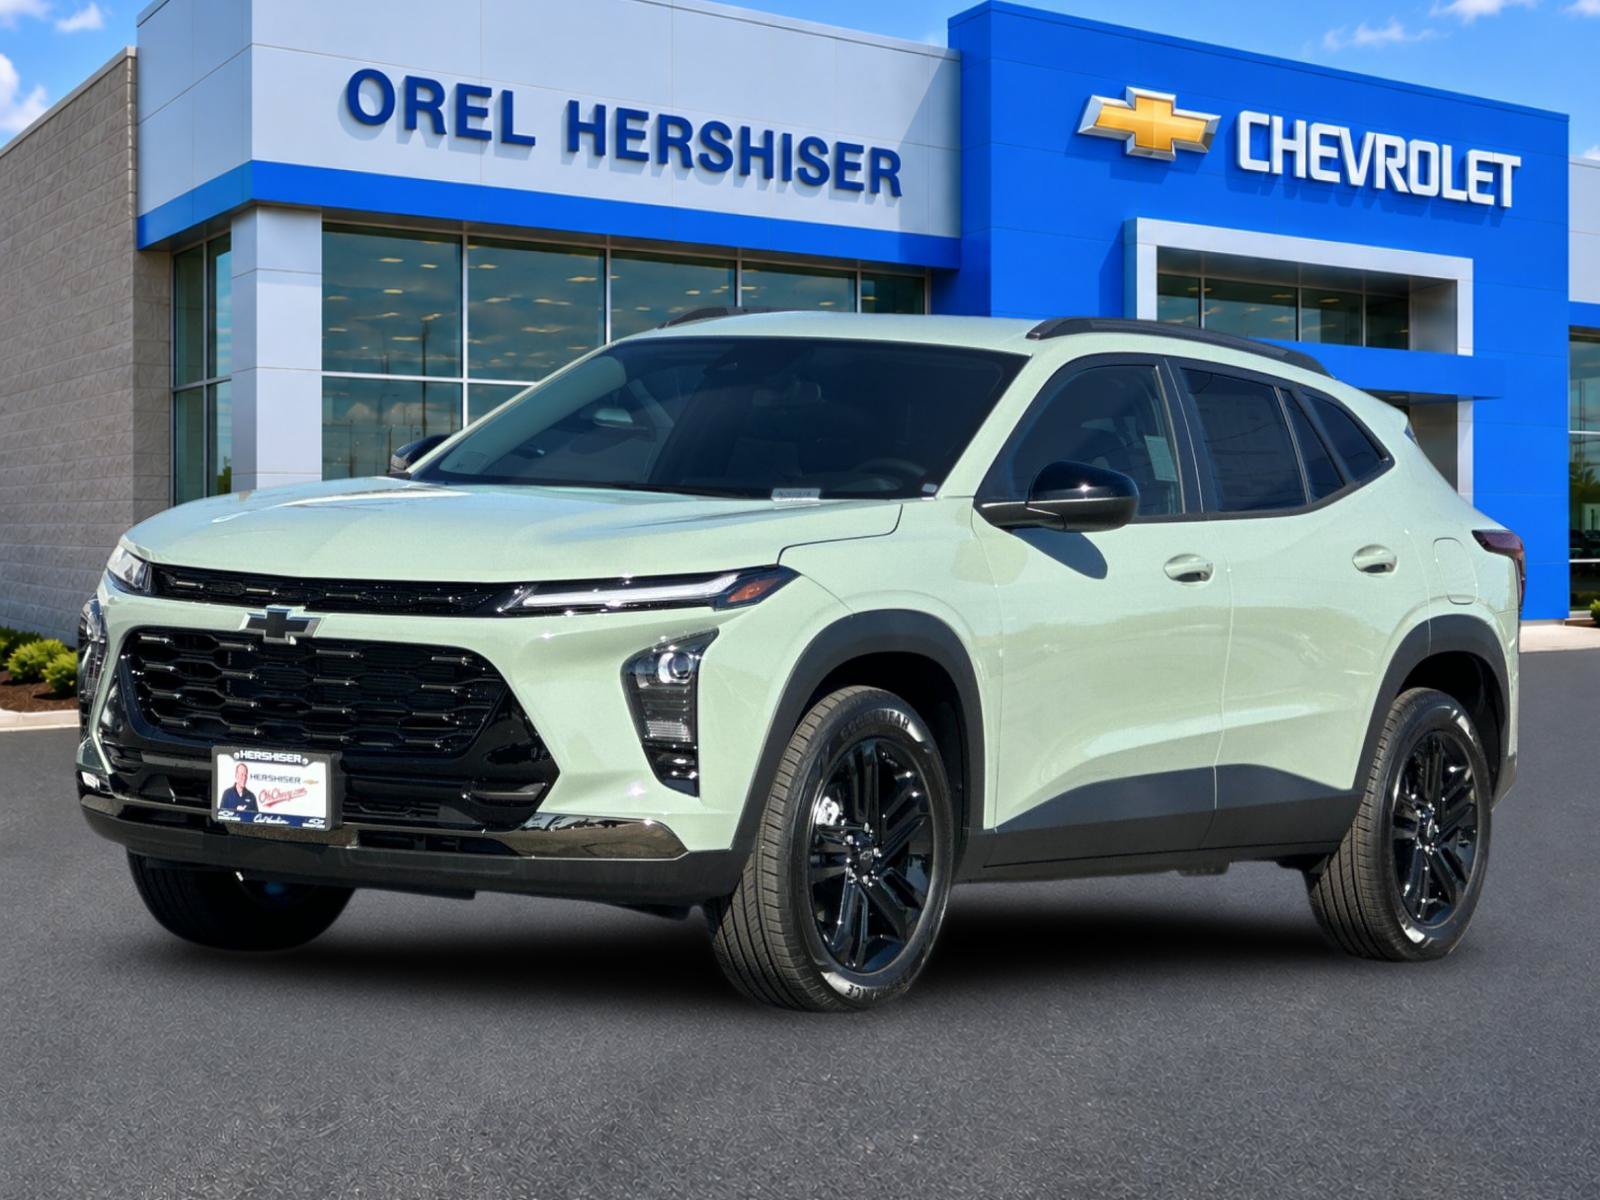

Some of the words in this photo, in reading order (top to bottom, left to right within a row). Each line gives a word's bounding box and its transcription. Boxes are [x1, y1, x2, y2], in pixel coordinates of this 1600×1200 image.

[346, 68, 535, 147] OREL
[567, 100, 902, 198] HERSHISER
[1236, 110, 1521, 208] CHEVROLET
[240, 750, 302, 763] HERSHISER
[250, 773, 301, 784] HERSHISER
